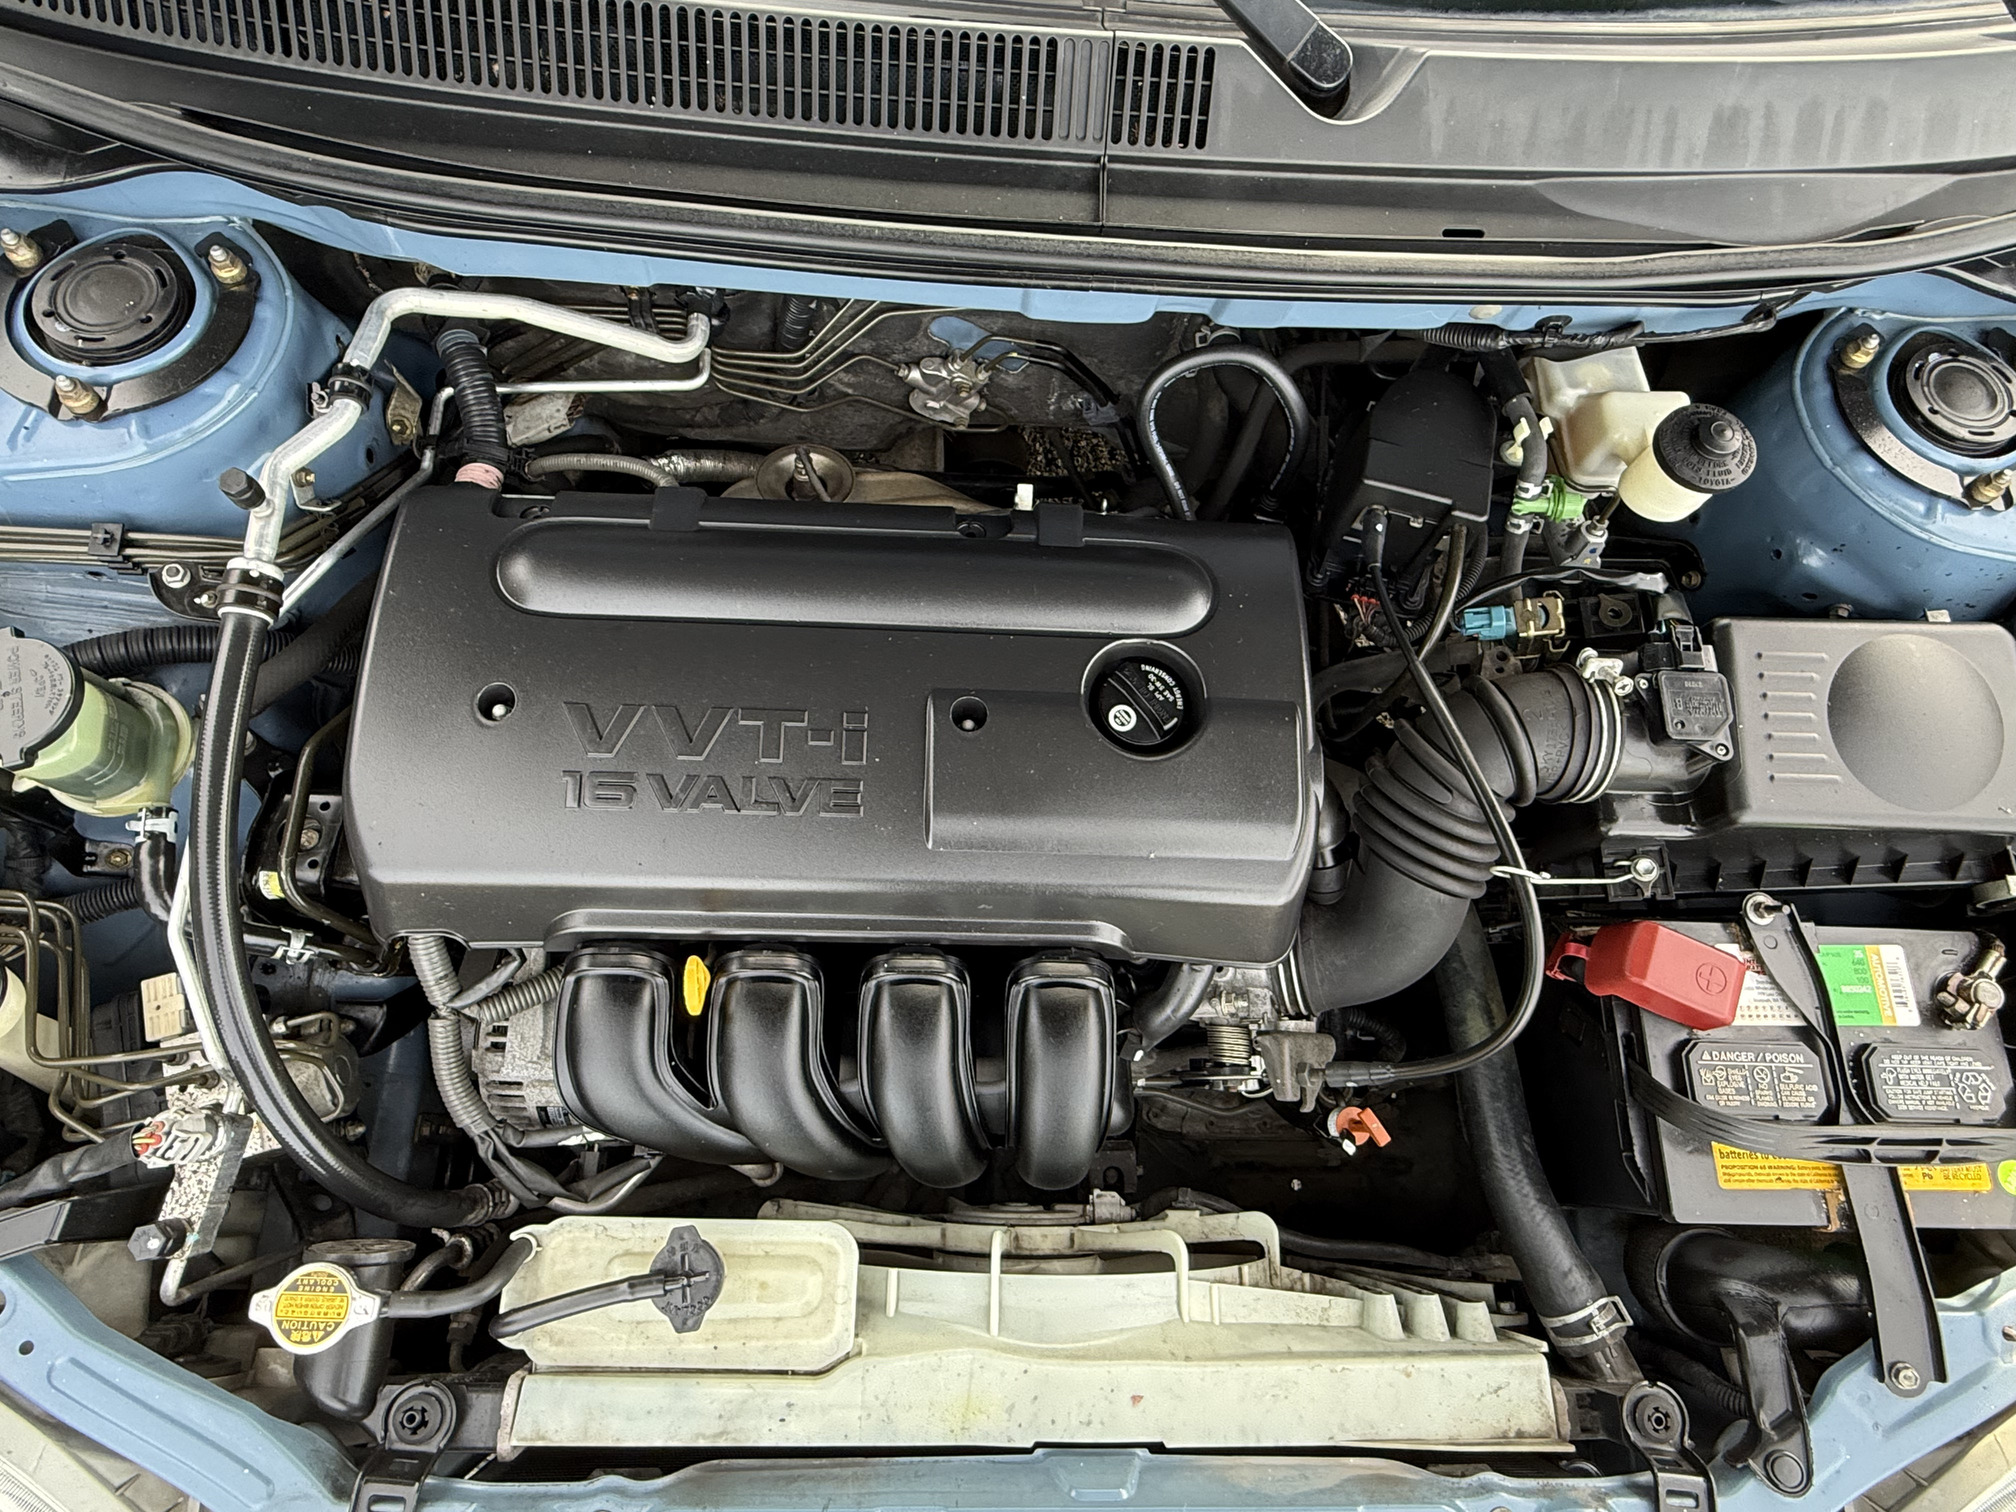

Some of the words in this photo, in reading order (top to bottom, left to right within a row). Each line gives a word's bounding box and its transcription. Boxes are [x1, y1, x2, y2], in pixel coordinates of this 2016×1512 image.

[1154, 691, 1165, 700] API
[1164, 690, 1174, 702] SAE
[563, 702, 868, 765] VVT-i
[561, 770, 638, 810] 16
[646, 773, 864, 818] VALVE
[1870, 953, 1893, 1017] AUTOMOTIVE
[1712, 1052, 1756, 1062] DANGER
[1766, 1053, 1804, 1063] POISON
[1718, 1148, 1758, 1159] batteries
[281, 1320, 335, 1330] CAUTION
